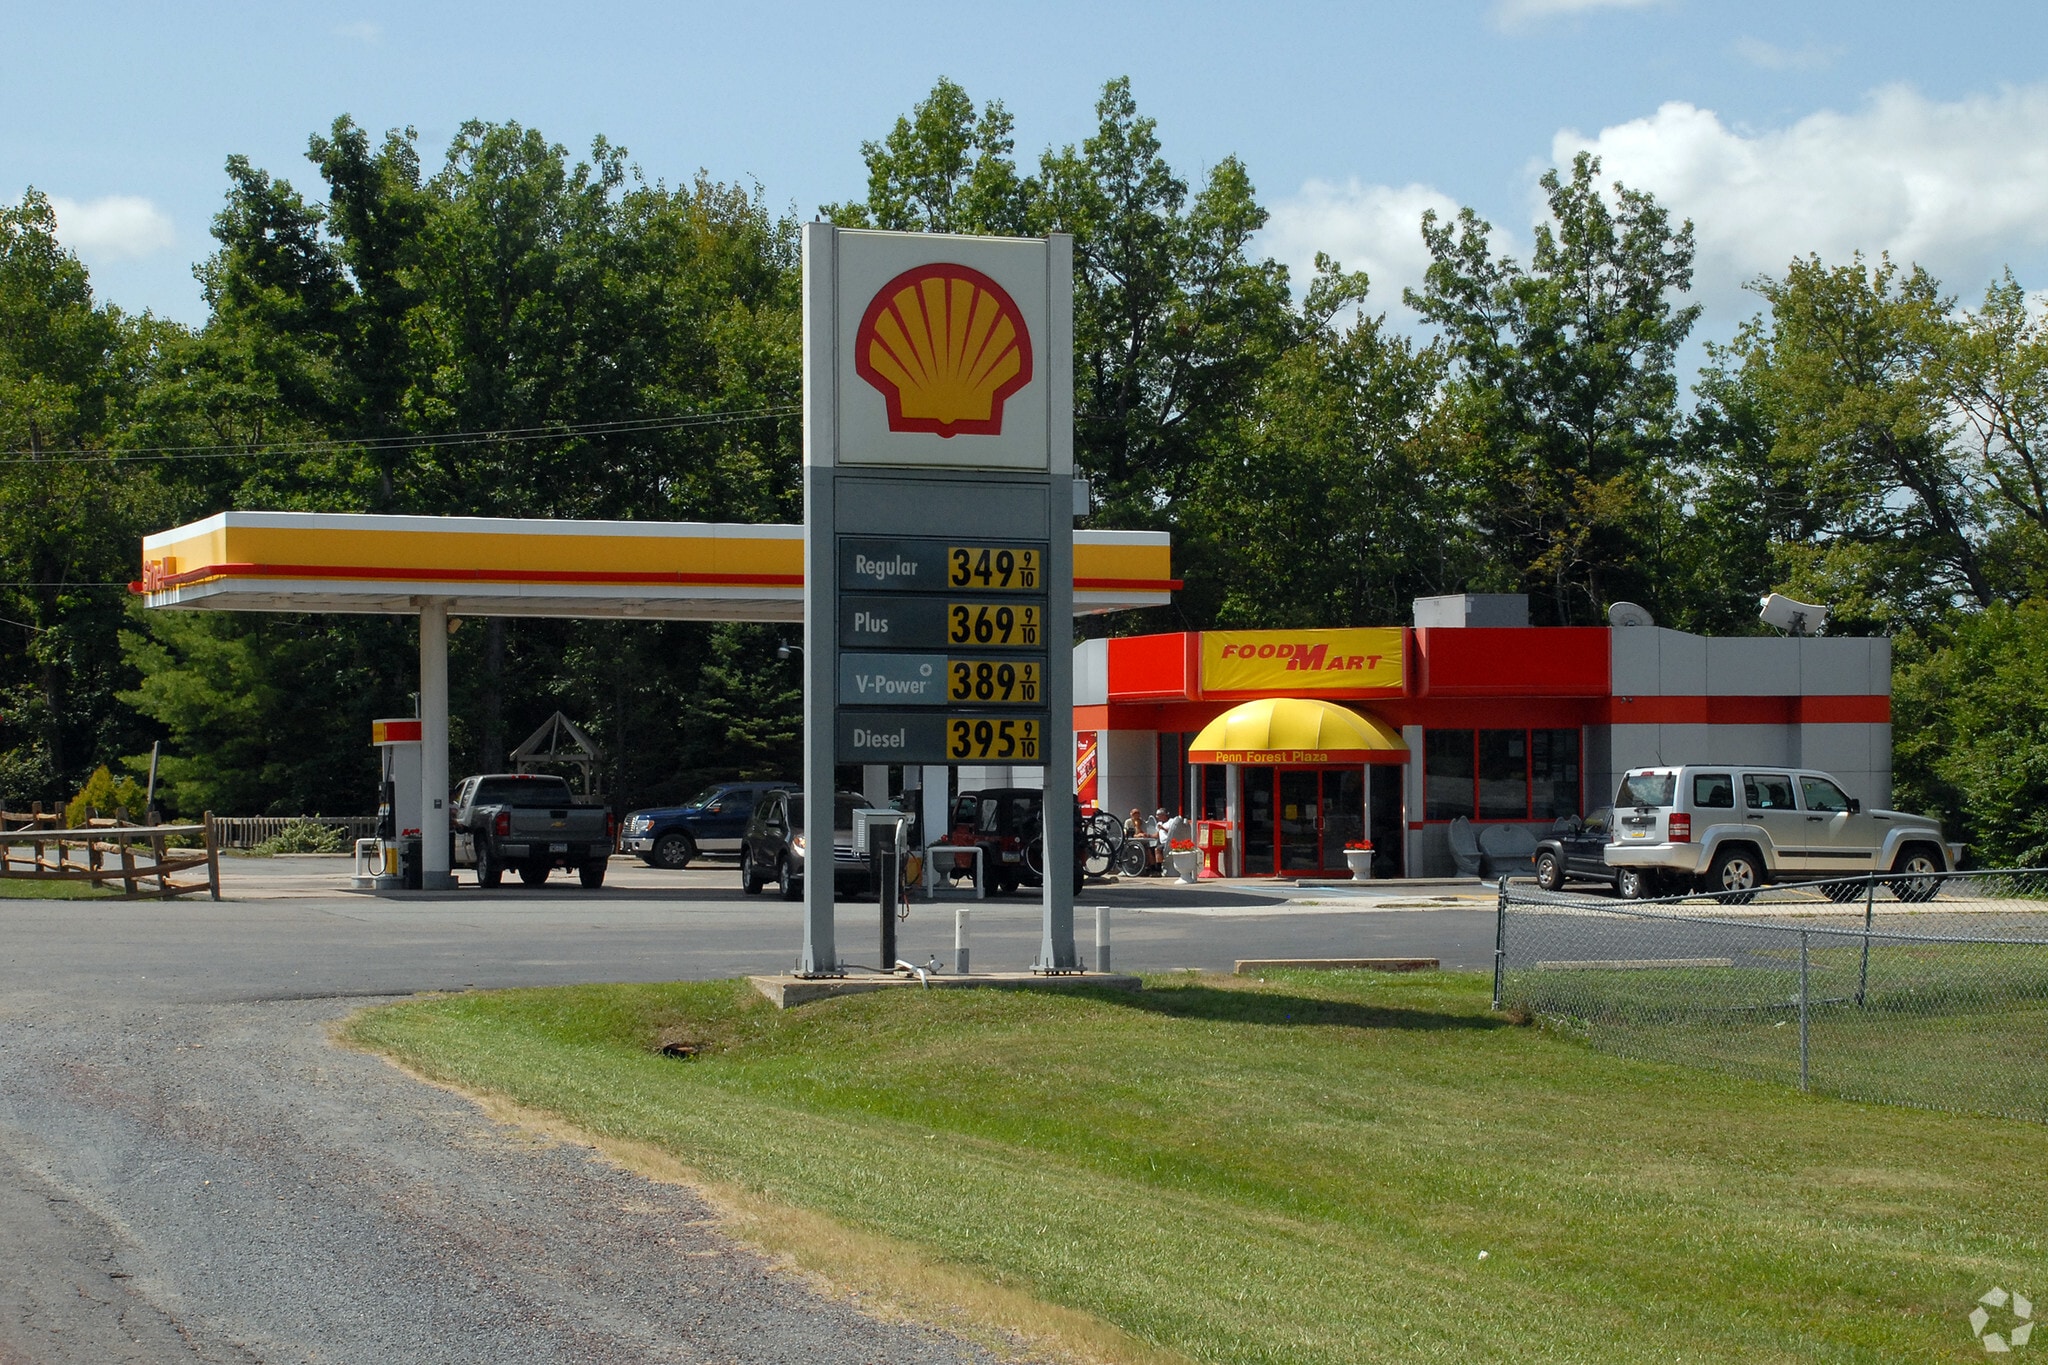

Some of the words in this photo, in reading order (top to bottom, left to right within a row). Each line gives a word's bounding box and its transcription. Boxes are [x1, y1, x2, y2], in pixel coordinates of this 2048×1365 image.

[856, 555, 918, 580] Regular
[952, 549, 1014, 587] 349
[855, 612, 888, 633] Plus
[951, 606, 1014, 643] 369
[856, 675, 927, 694] V-Power
[952, 663, 1016, 701] 389
[854, 728, 905, 747] Diesel
[952, 721, 1015, 758] 395
[1216, 752, 1242, 762] Penn
[1247, 751, 1287, 762] Forest
[1293, 751, 1328, 762] Plaza
